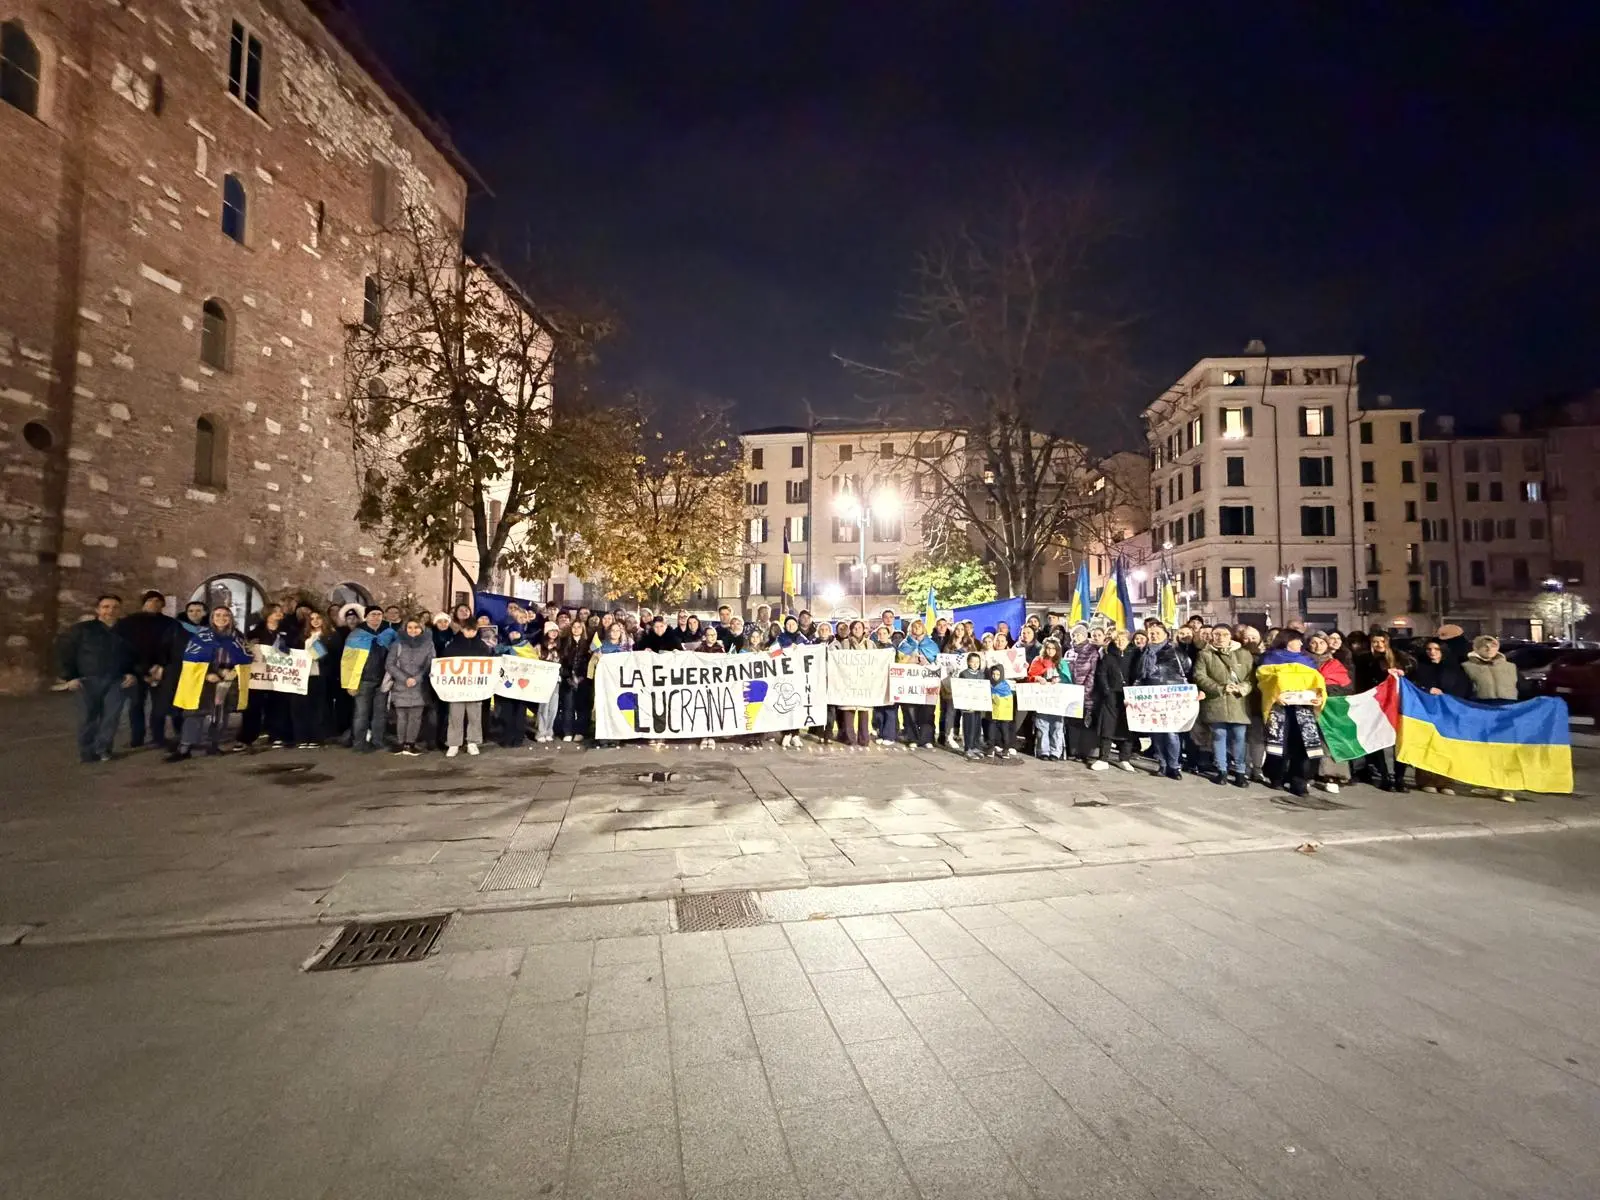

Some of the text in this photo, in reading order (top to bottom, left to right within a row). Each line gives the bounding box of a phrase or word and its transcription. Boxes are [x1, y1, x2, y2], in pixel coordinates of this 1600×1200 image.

[436, 659, 493, 675] TUTTI
[620, 666, 645, 688] LA
[652, 665, 738, 686] GUERRA
[739, 658, 777, 680] NON
[890, 667, 905, 677] STOP
[907, 669, 919, 677] ALLA
[441, 675, 488, 686] BAMBINI
